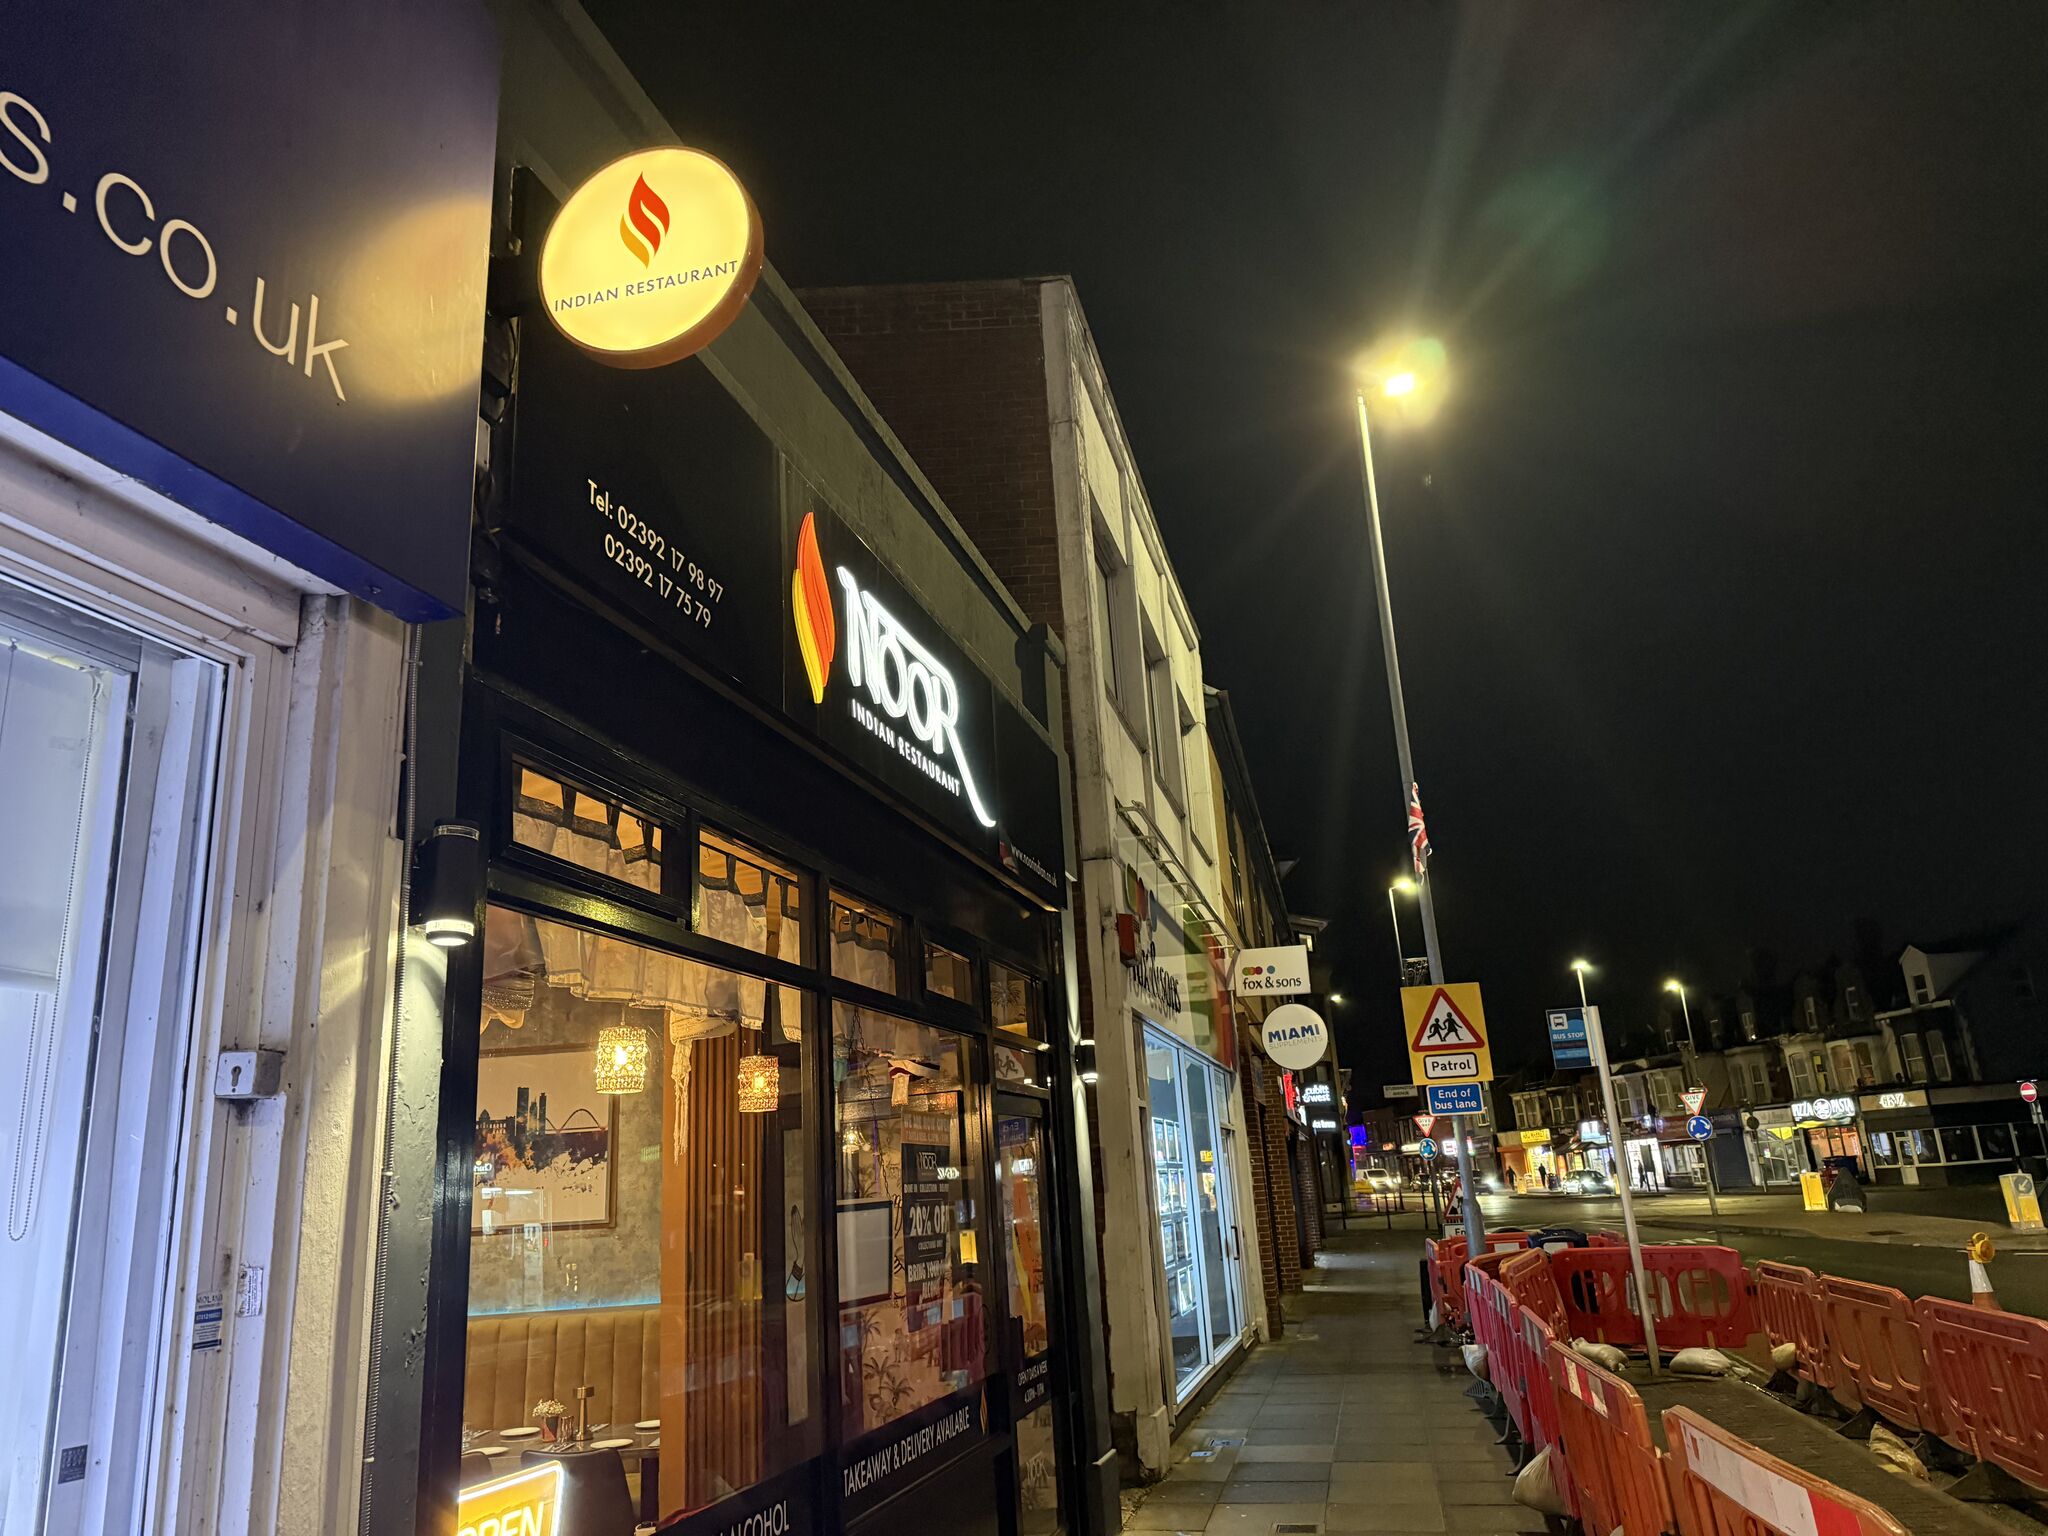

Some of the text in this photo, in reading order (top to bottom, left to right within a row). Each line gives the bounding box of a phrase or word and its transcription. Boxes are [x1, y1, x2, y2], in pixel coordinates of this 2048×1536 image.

[554, 259, 739, 312] INDIAN RESTAURANT
[587, 478, 724, 604] Tel: 02392 17 98 97
[604, 533, 711, 629] 02392 17 75 79
[836, 566, 996, 828] NOOR
[851, 698, 961, 797] INDIAN RESTAURANT
[1243, 976, 1302, 990] fox & sons
[1268, 1024, 1320, 1043] MIAMI
[1269, 1036, 1324, 1050] SUPPLEMENTS
[1431, 1059, 1472, 1071] Patrol
[1434, 1100, 1477, 1110] bus lane
[1438, 1088, 1471, 1099] End of
[909, 1205, 932, 1237] 20%
[907, 1261, 926, 1283] BRING
[843, 1405, 970, 1498] TAKEAWAY & DELIVERY AVAILABLE
